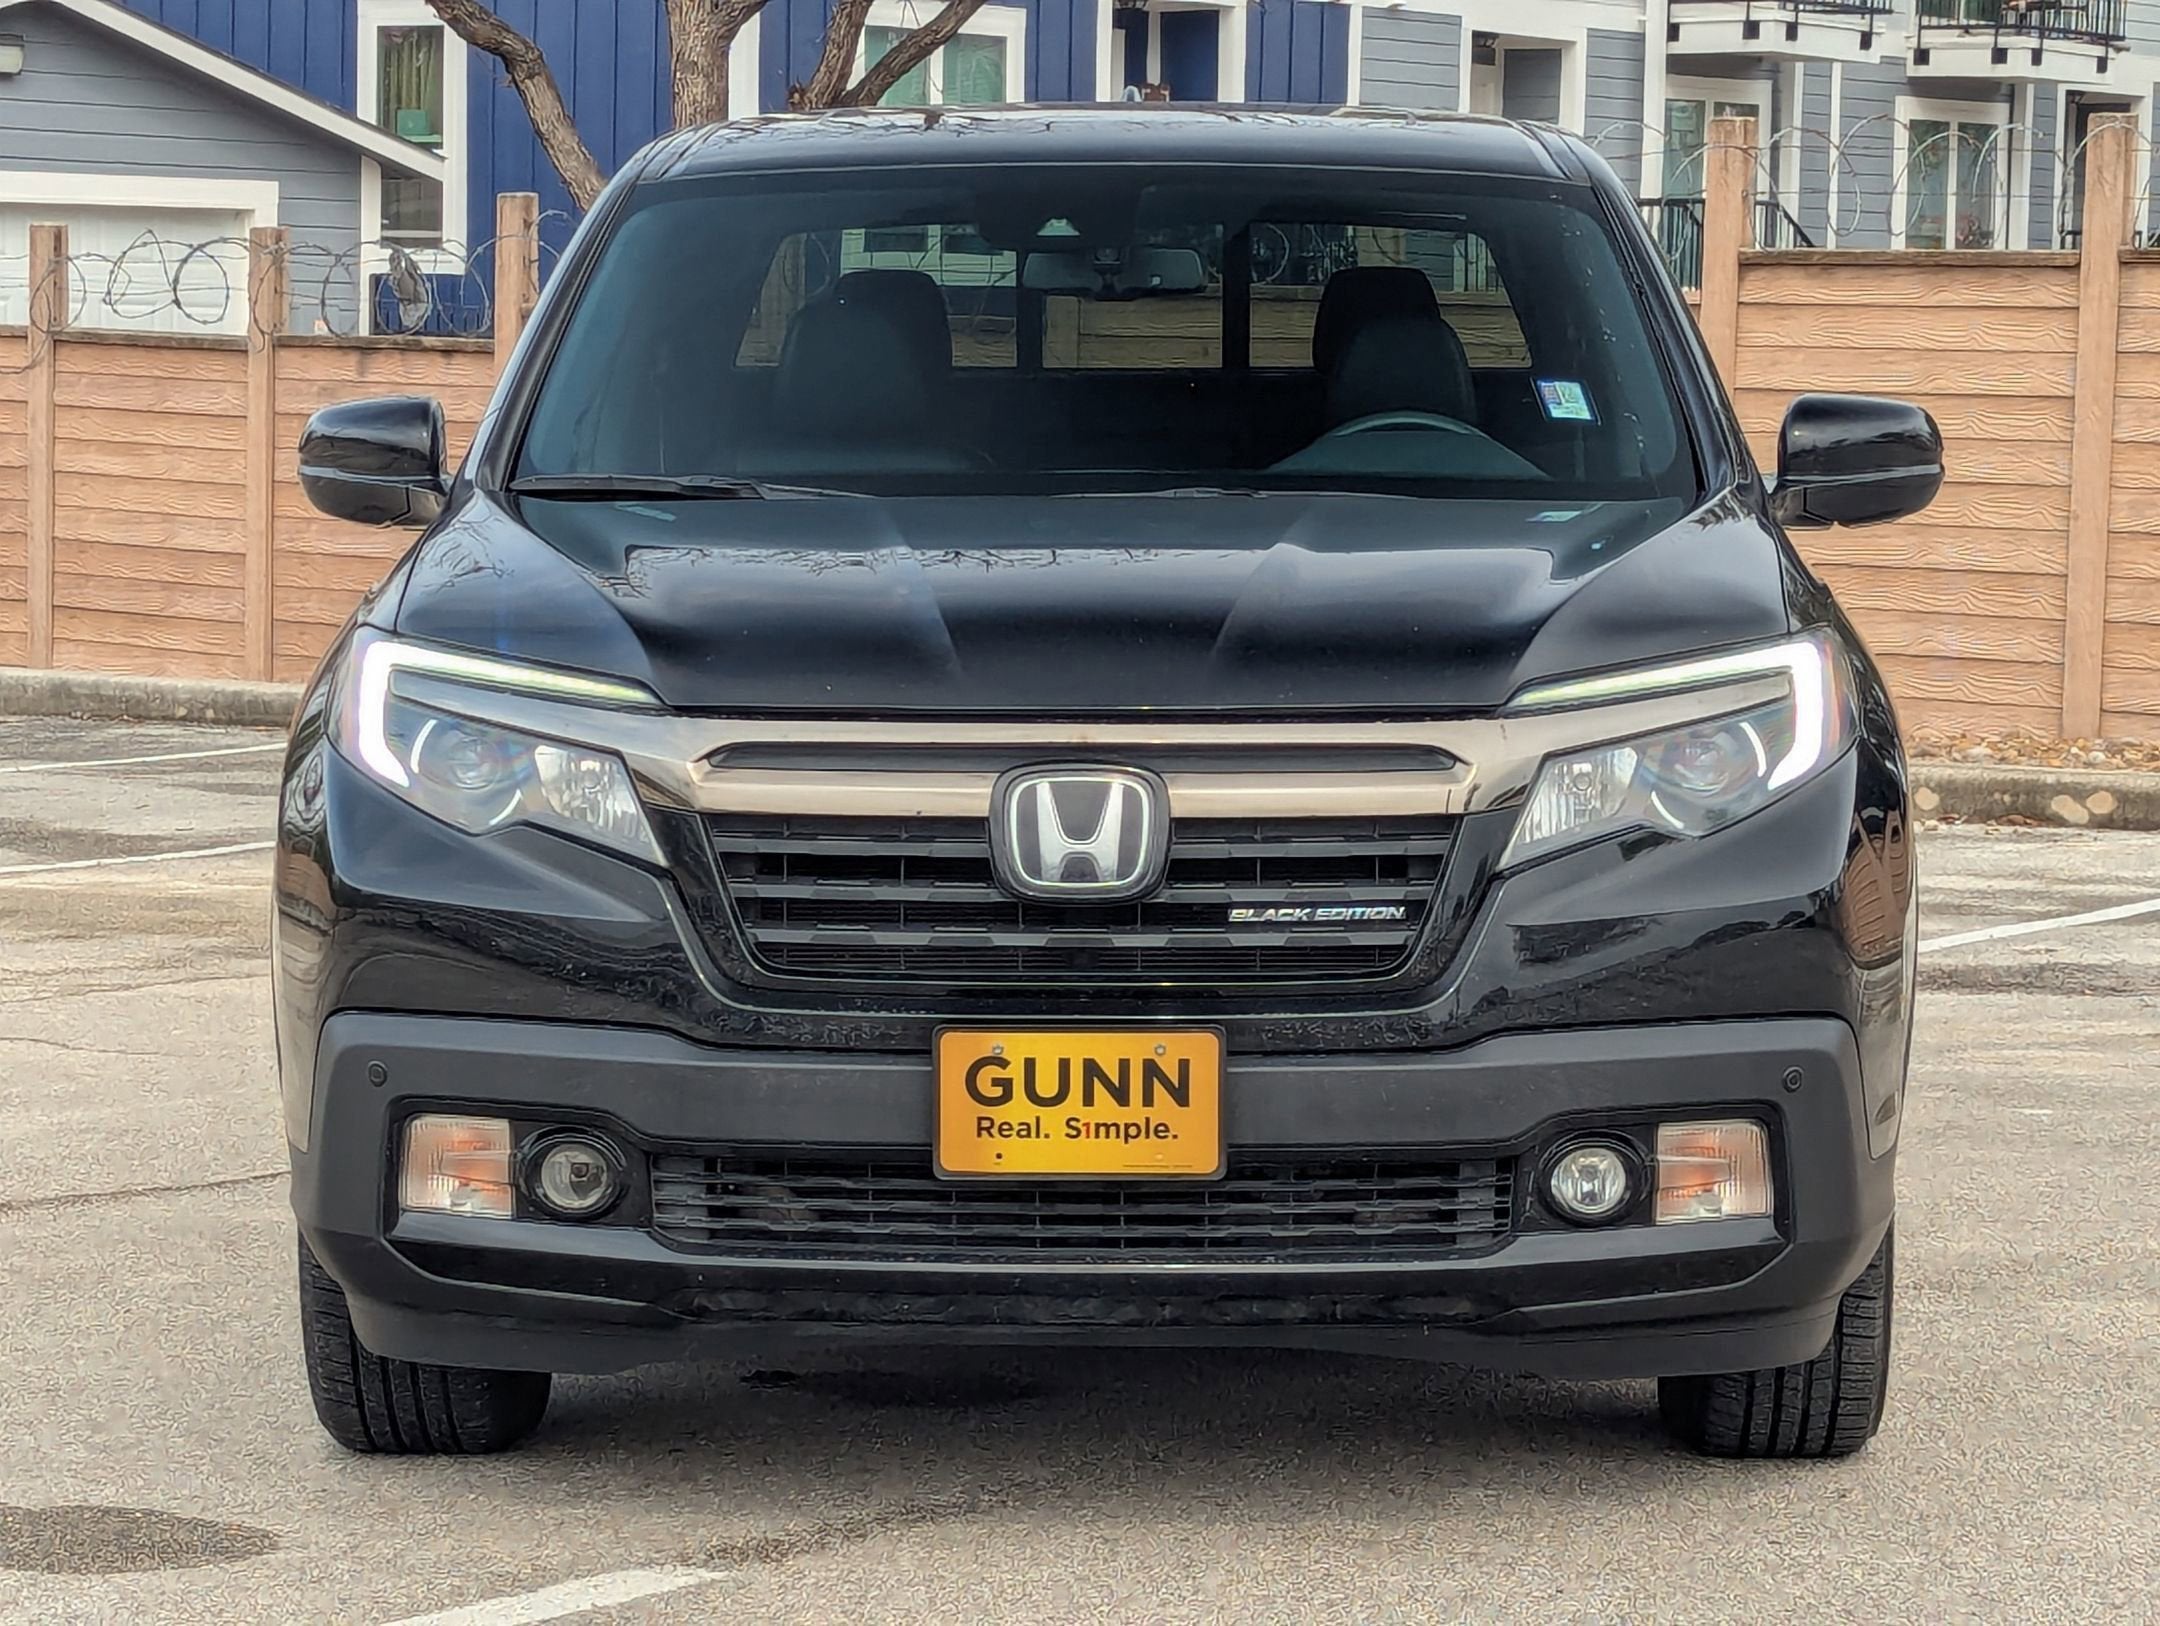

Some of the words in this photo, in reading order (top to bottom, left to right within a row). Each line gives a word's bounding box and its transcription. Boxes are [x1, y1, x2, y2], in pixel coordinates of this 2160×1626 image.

[1228, 908, 1311, 922] BLACK
[1314, 906, 1406, 921] EDITION
[965, 1055, 1190, 1108] GUNN
[976, 1116, 1050, 1139] Real.
